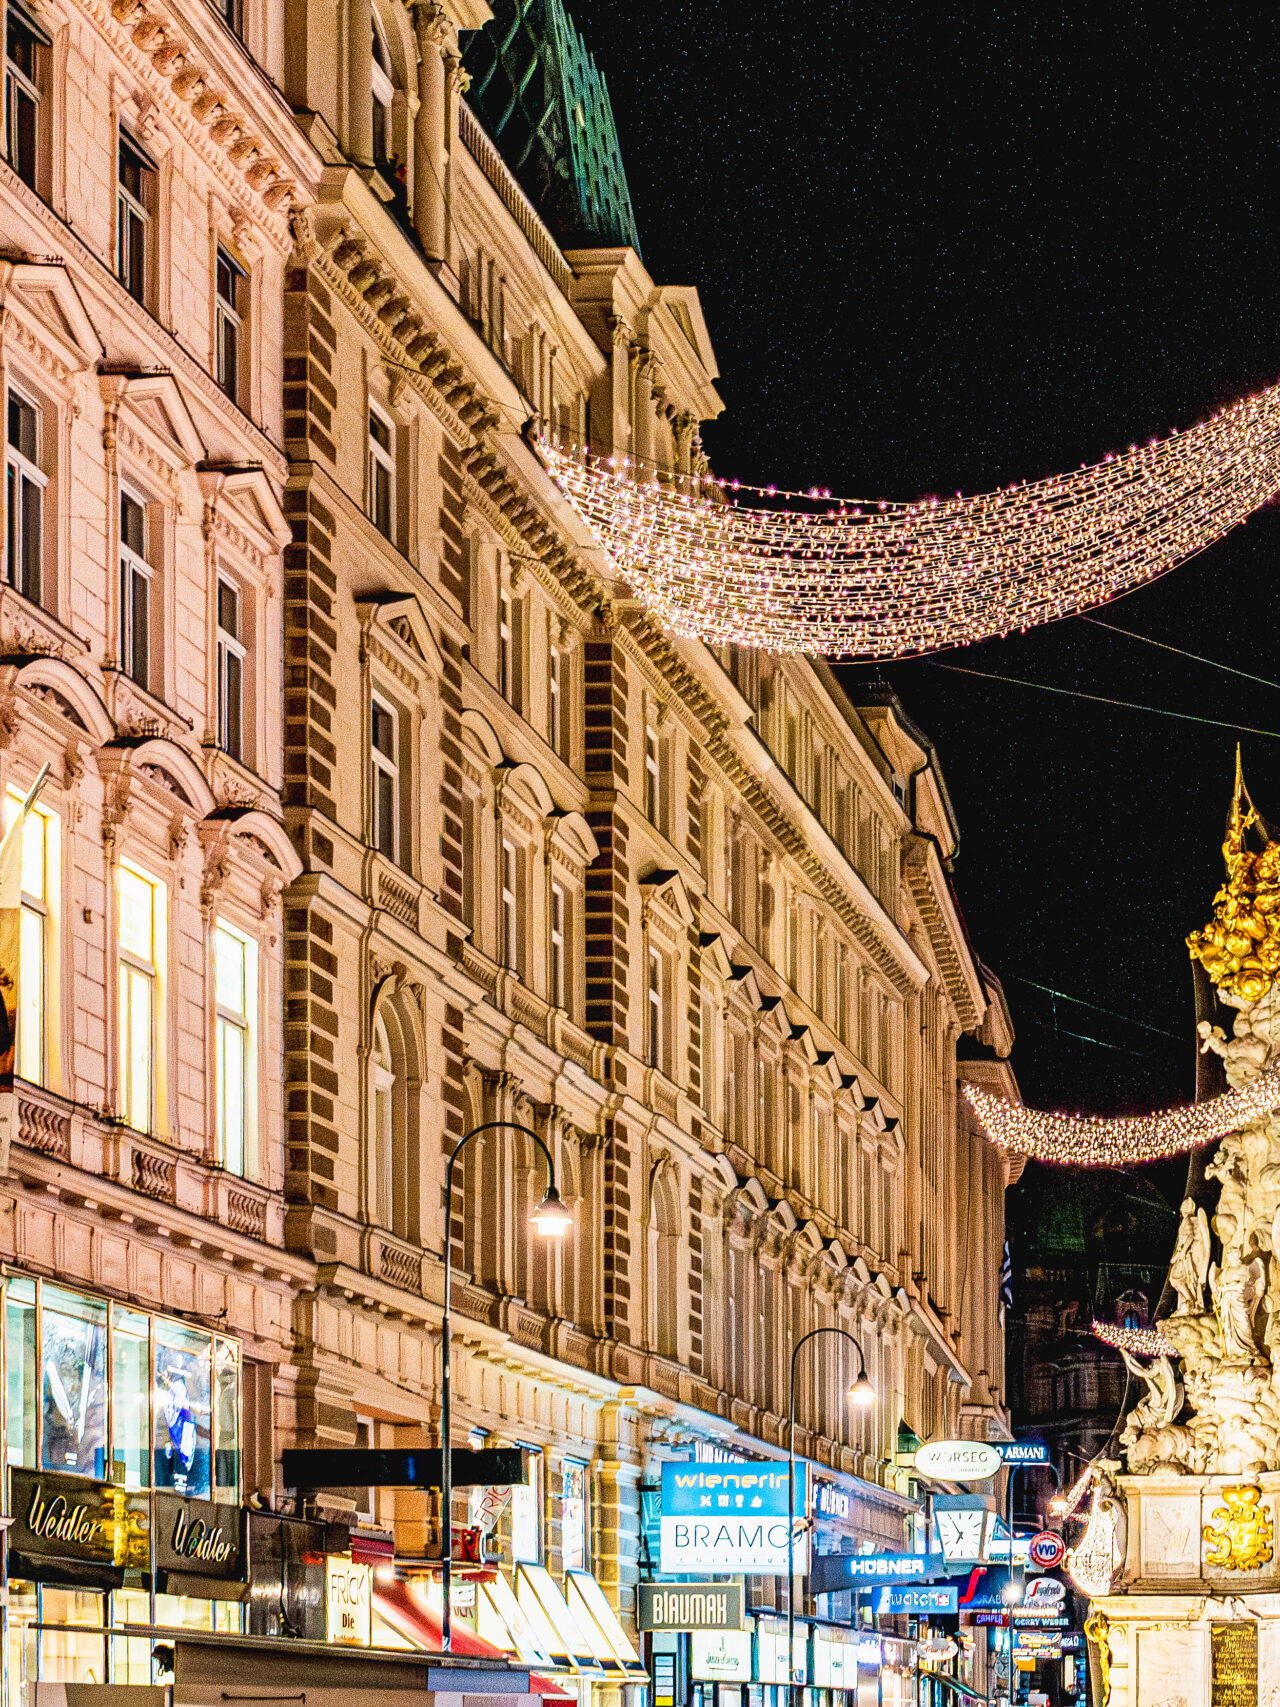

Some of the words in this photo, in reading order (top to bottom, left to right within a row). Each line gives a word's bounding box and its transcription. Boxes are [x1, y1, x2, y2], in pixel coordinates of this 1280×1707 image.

[928, 1451, 988, 1463] WORSEG
[1005, 1447, 1044, 1459] ARMANI
[28, 1484, 103, 1544] Weidler
[474, 1486, 511, 1526] FRIC
[173, 1508, 236, 1562] Weidler
[886, 1591, 938, 1607] watch
[341, 1613, 355, 1630] Die
[976, 1614, 1003, 1625] CAMPER
[1014, 1618, 1040, 1626] GERRY
[1041, 1618, 1069, 1626] WEBER
